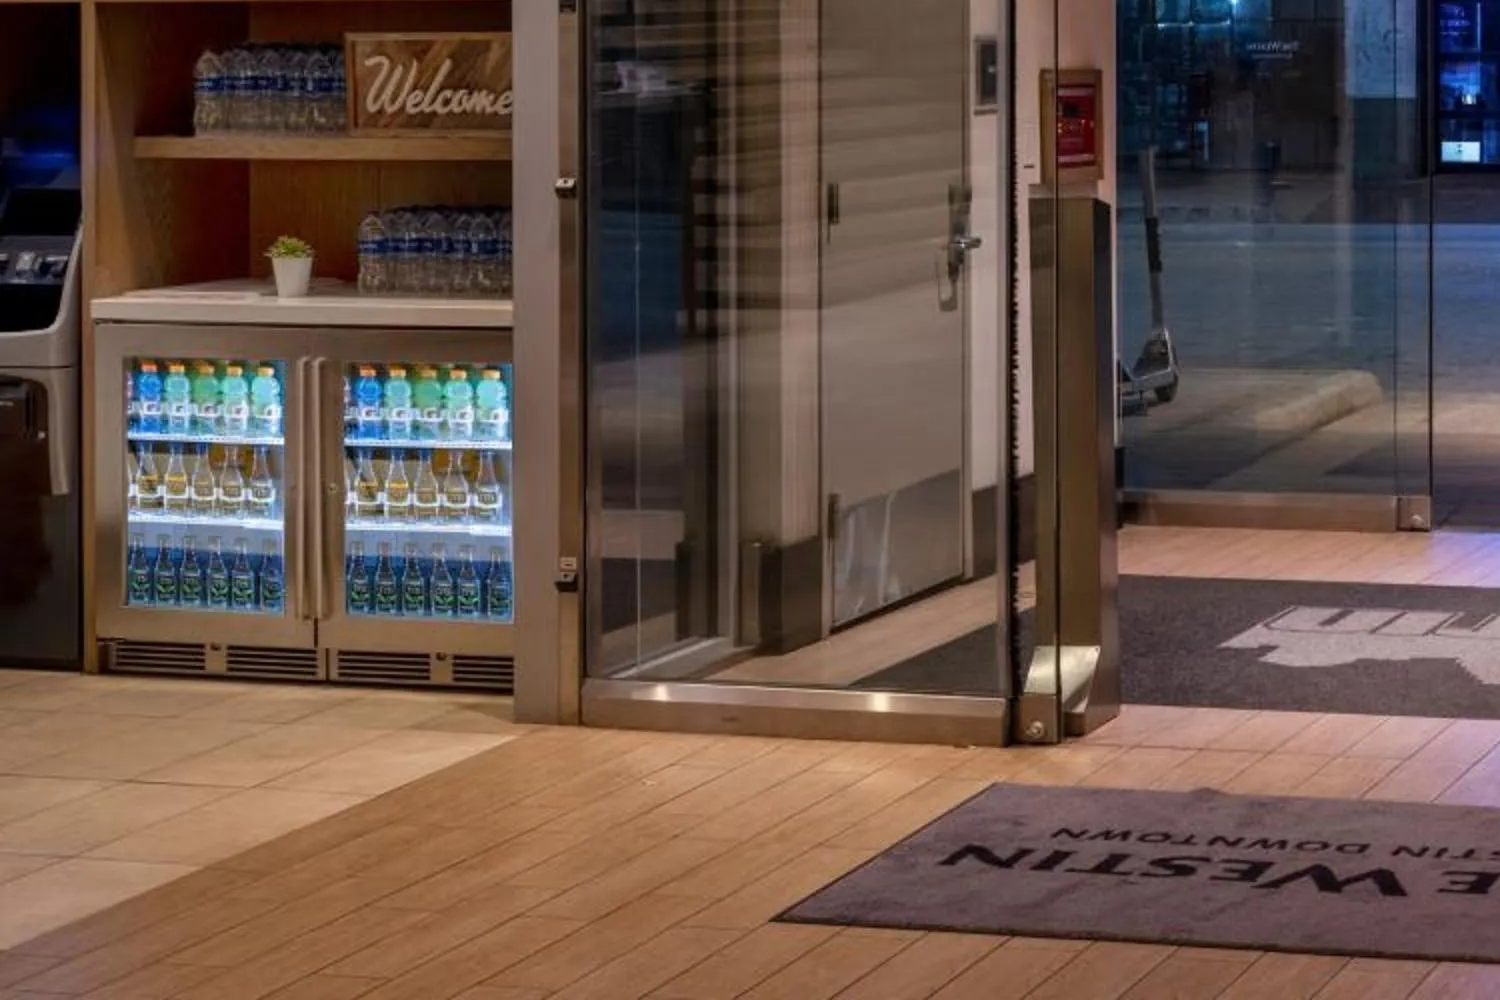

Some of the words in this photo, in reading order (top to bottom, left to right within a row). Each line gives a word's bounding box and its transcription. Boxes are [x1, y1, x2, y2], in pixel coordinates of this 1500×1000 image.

[364, 55, 513, 115] Welcome
[1050, 827, 1371, 854] DOWNTOWN
[938, 844, 1408, 897] WESTIN
